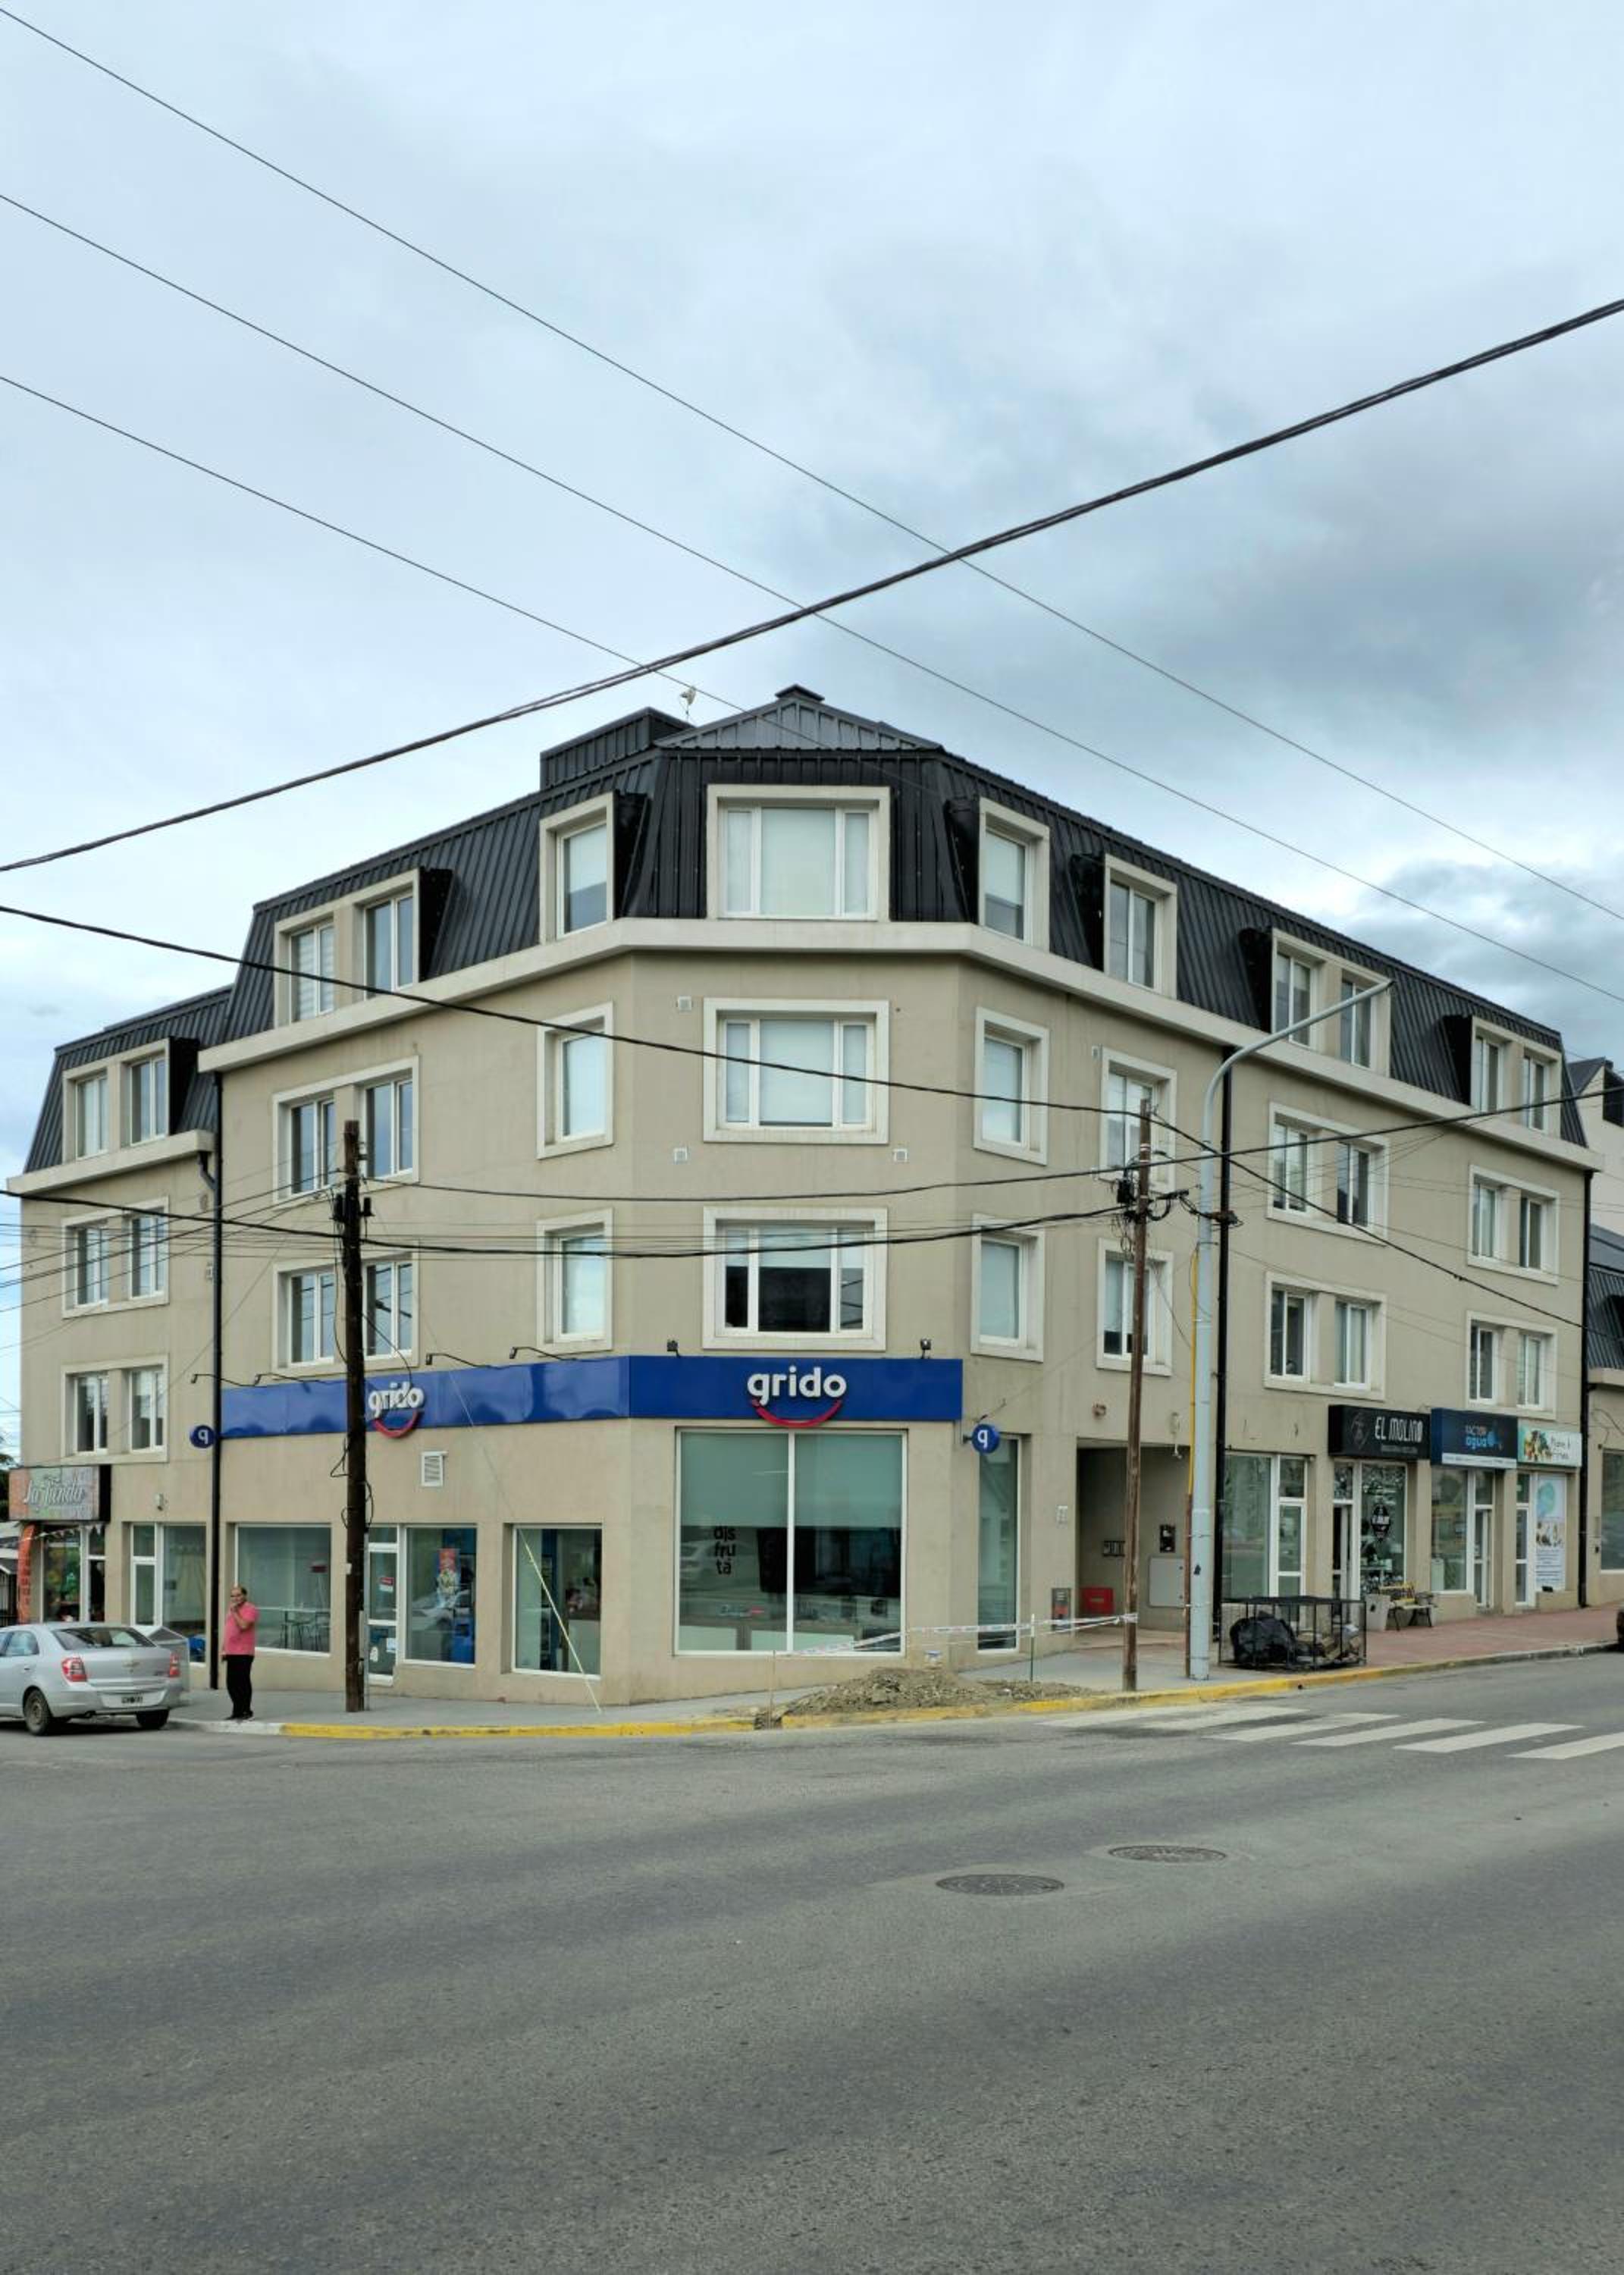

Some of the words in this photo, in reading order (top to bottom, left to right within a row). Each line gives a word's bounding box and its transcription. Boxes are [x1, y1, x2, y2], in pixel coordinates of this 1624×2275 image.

[368, 1381, 425, 1418] grido
[747, 1365, 848, 1407] grido
[1375, 1416, 1387, 1440] EL
